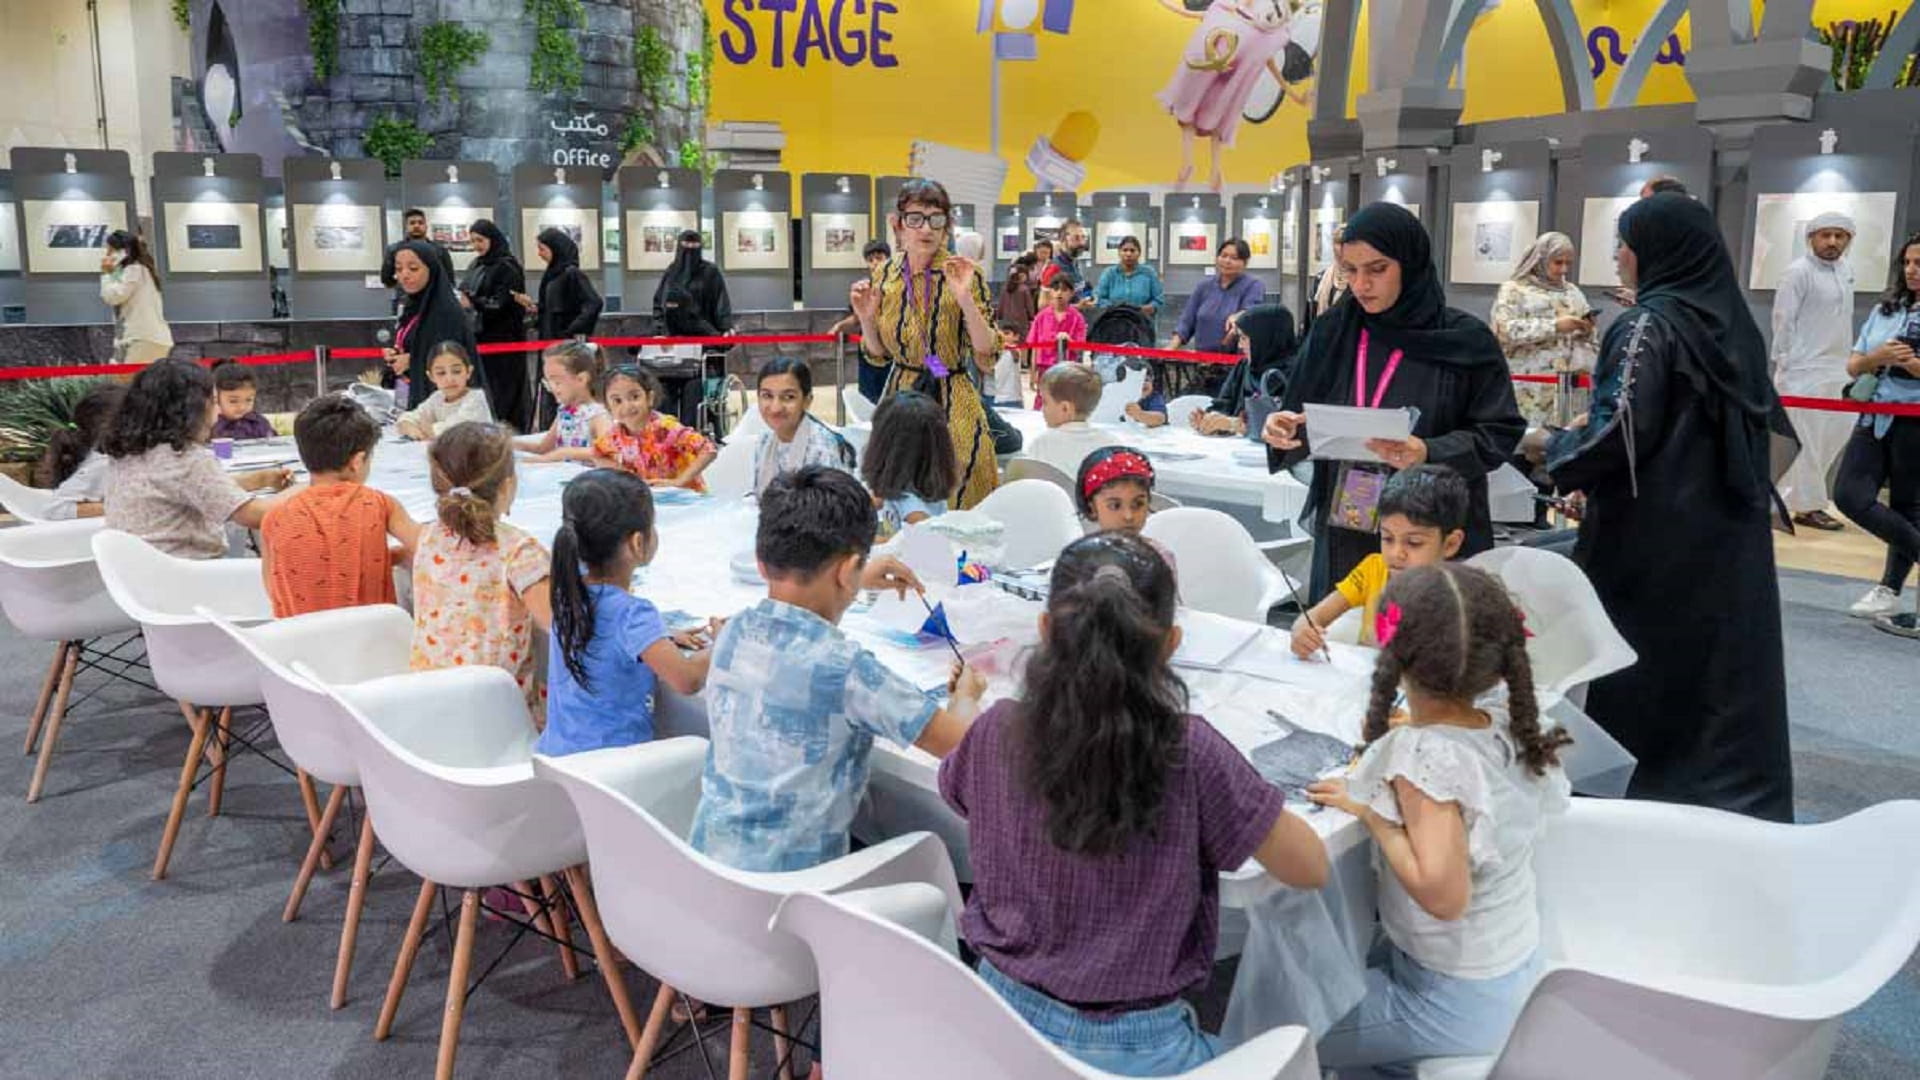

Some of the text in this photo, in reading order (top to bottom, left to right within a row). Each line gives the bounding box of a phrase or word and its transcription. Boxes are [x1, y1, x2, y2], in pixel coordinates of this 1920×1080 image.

[720, 0, 899, 68] STAGE
[551, 113, 608, 137] مكتب
[553, 148, 611, 168] Office
